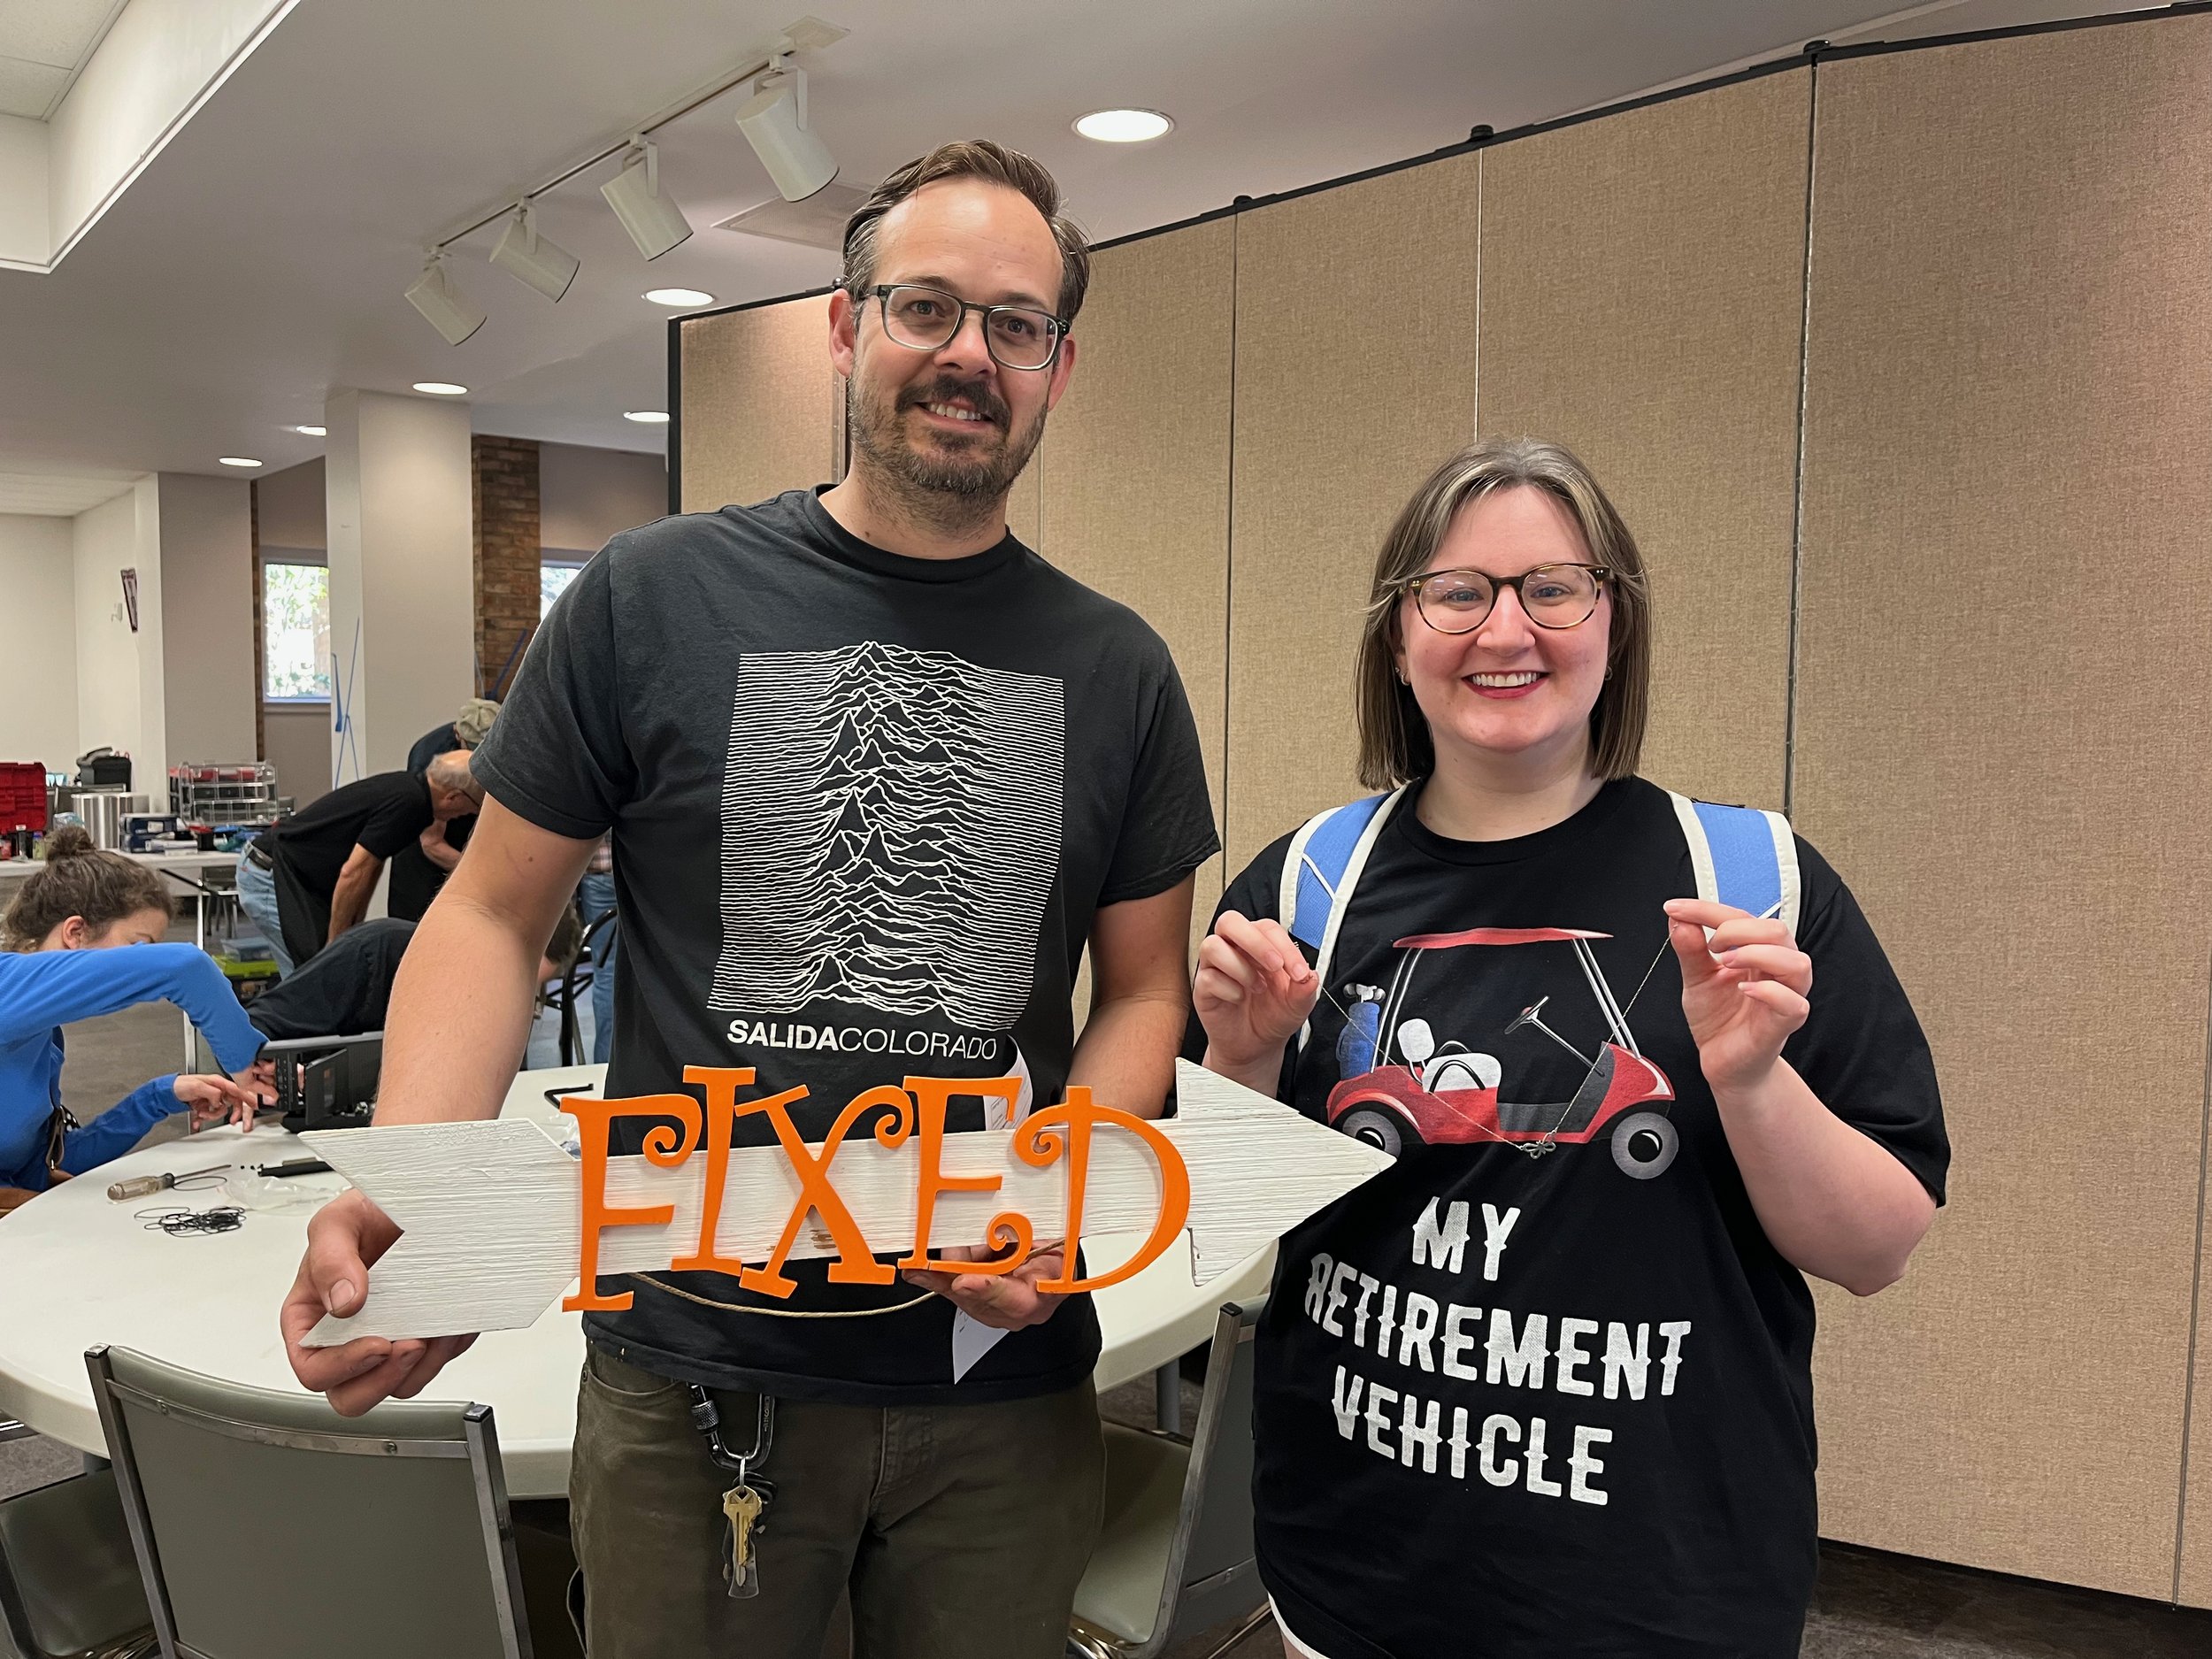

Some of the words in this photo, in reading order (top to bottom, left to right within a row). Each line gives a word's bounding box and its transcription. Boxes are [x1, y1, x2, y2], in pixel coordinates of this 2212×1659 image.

[560, 1064, 1191, 1312] FIXED
[1411, 1195, 1521, 1281] MY
[1304, 1252, 1692, 1401] RETIREMENT
[1331, 1364, 1613, 1506] VEHICLE
